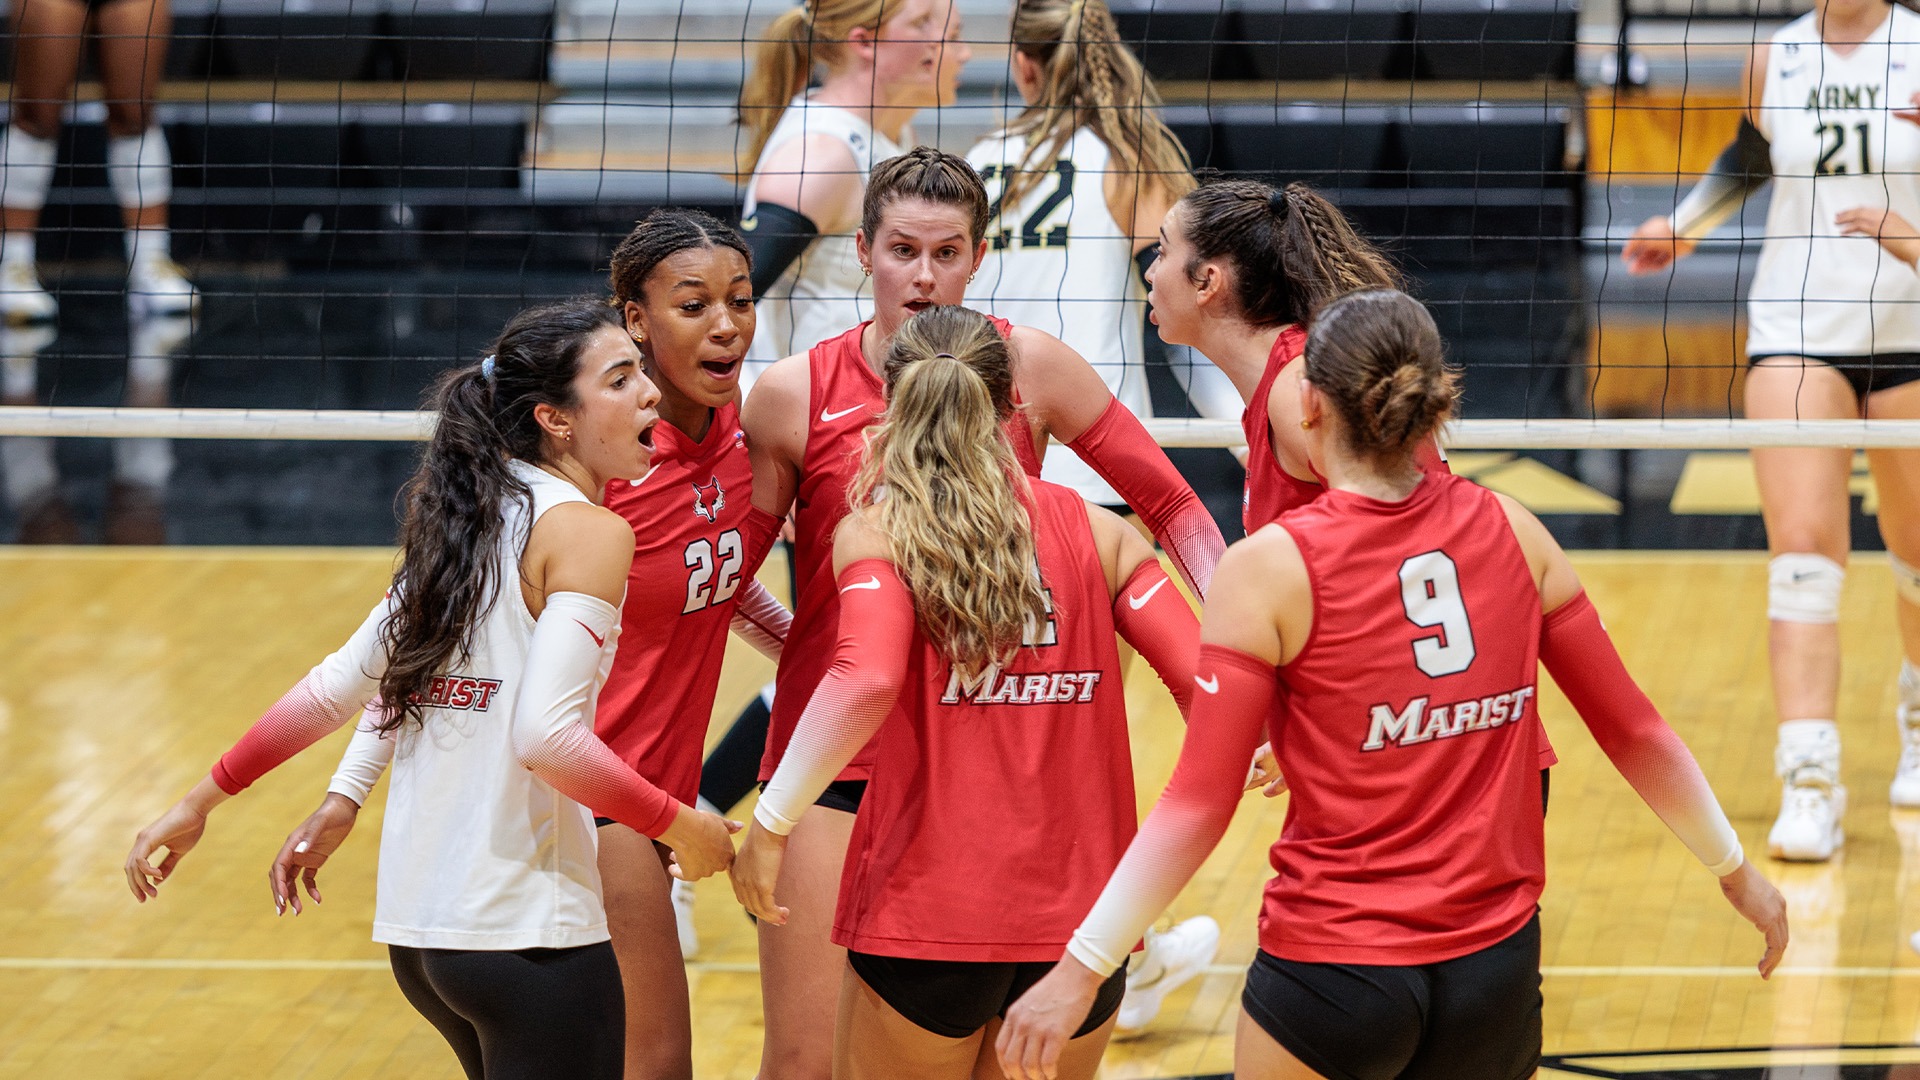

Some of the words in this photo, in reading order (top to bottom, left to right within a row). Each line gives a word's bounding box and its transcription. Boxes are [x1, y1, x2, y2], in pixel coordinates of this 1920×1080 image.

[1804, 84, 1881, 113] ARMY
[1813, 120, 1872, 176] 21
[980, 159, 1076, 251] 22
[680, 527, 743, 616] 22
[1398, 548, 1477, 679] 9
